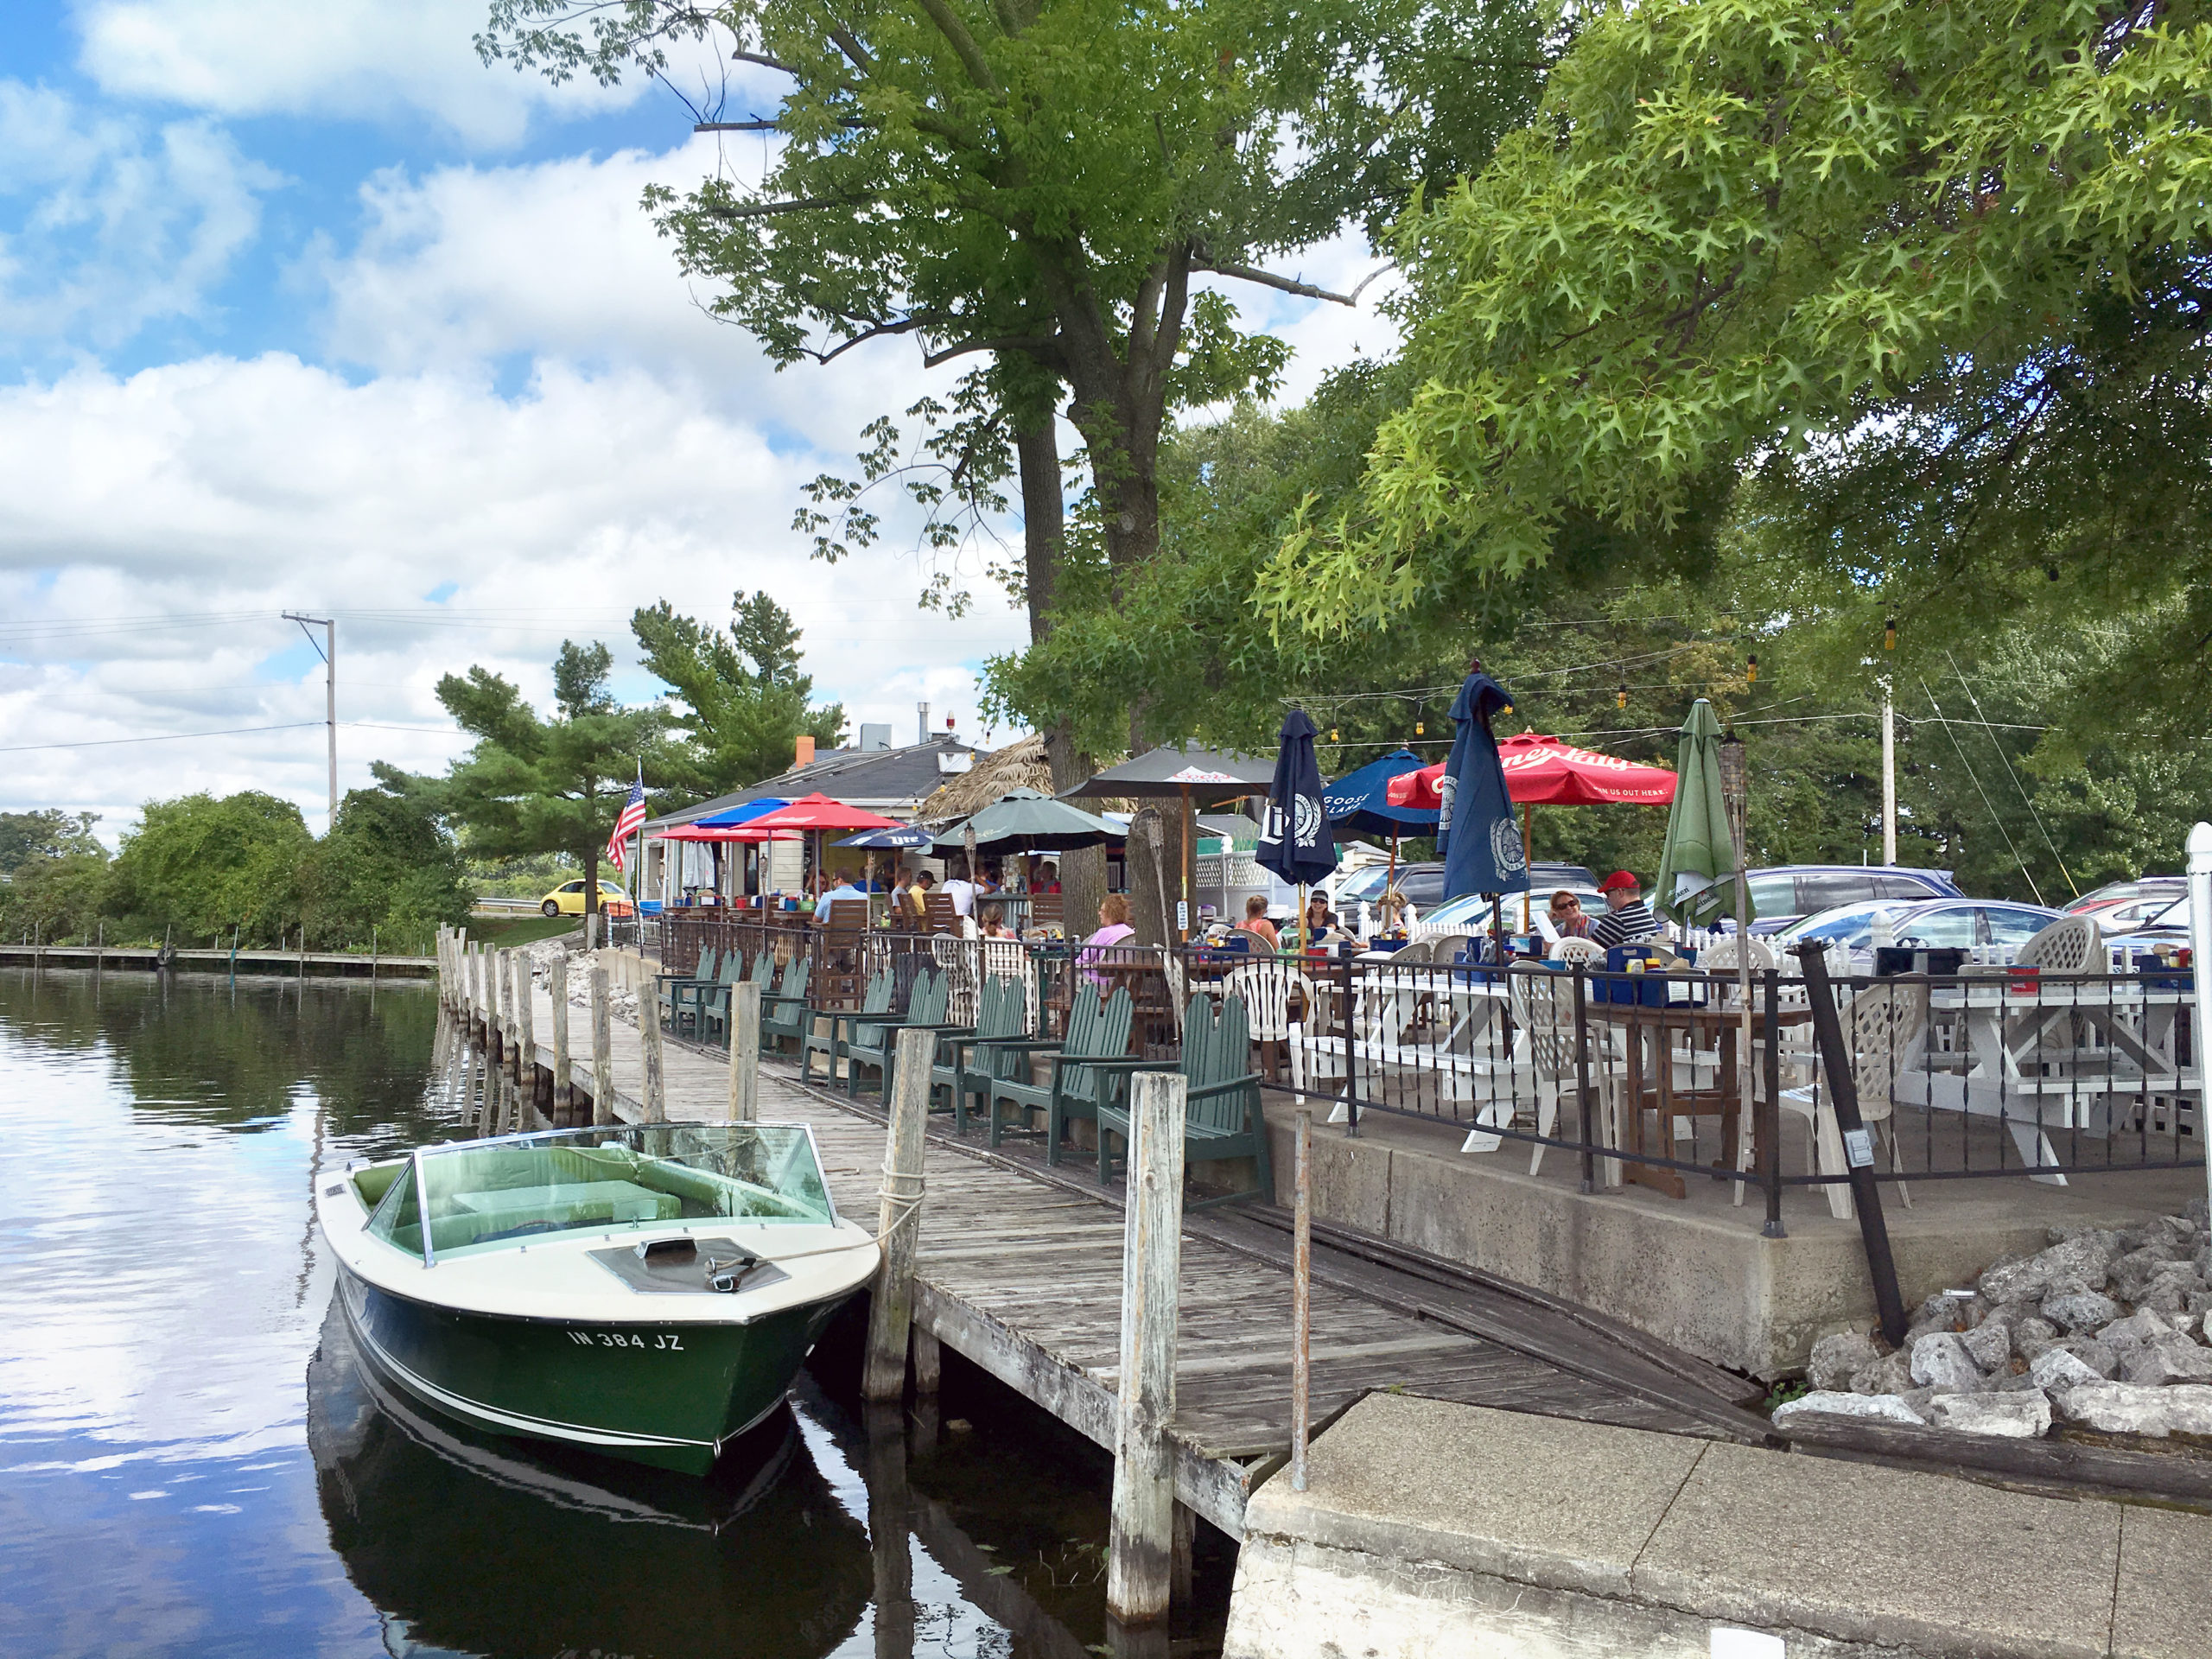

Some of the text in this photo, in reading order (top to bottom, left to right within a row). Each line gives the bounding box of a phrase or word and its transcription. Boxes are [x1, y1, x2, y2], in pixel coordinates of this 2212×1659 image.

[567, 1331, 684, 1351] IN 384 JZ
